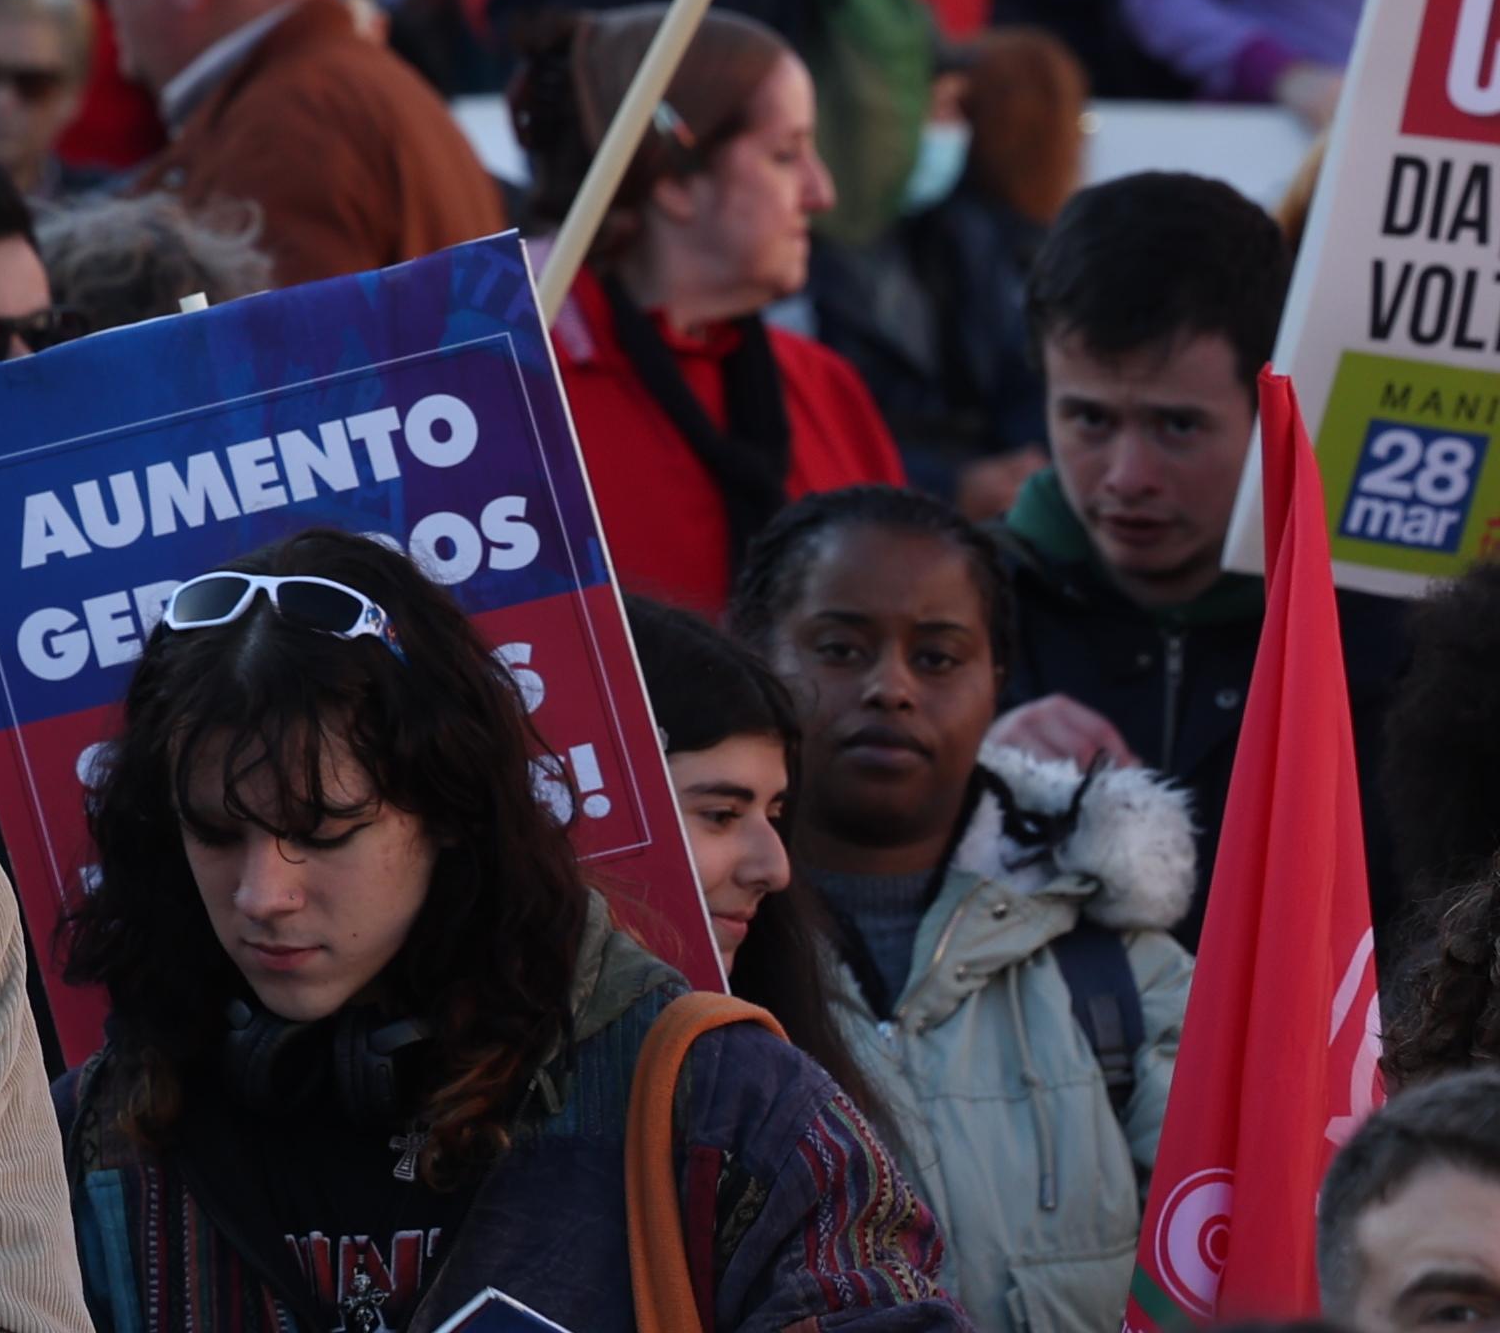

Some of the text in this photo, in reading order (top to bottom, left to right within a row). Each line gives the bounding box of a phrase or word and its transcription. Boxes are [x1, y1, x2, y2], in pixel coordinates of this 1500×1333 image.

[1382, 155, 1491, 245] DIA
[19, 393, 478, 569] AUMENTO
[1359, 429, 1475, 505] 28
[352, 495, 540, 585] OS
[1345, 496, 1462, 547] mar
